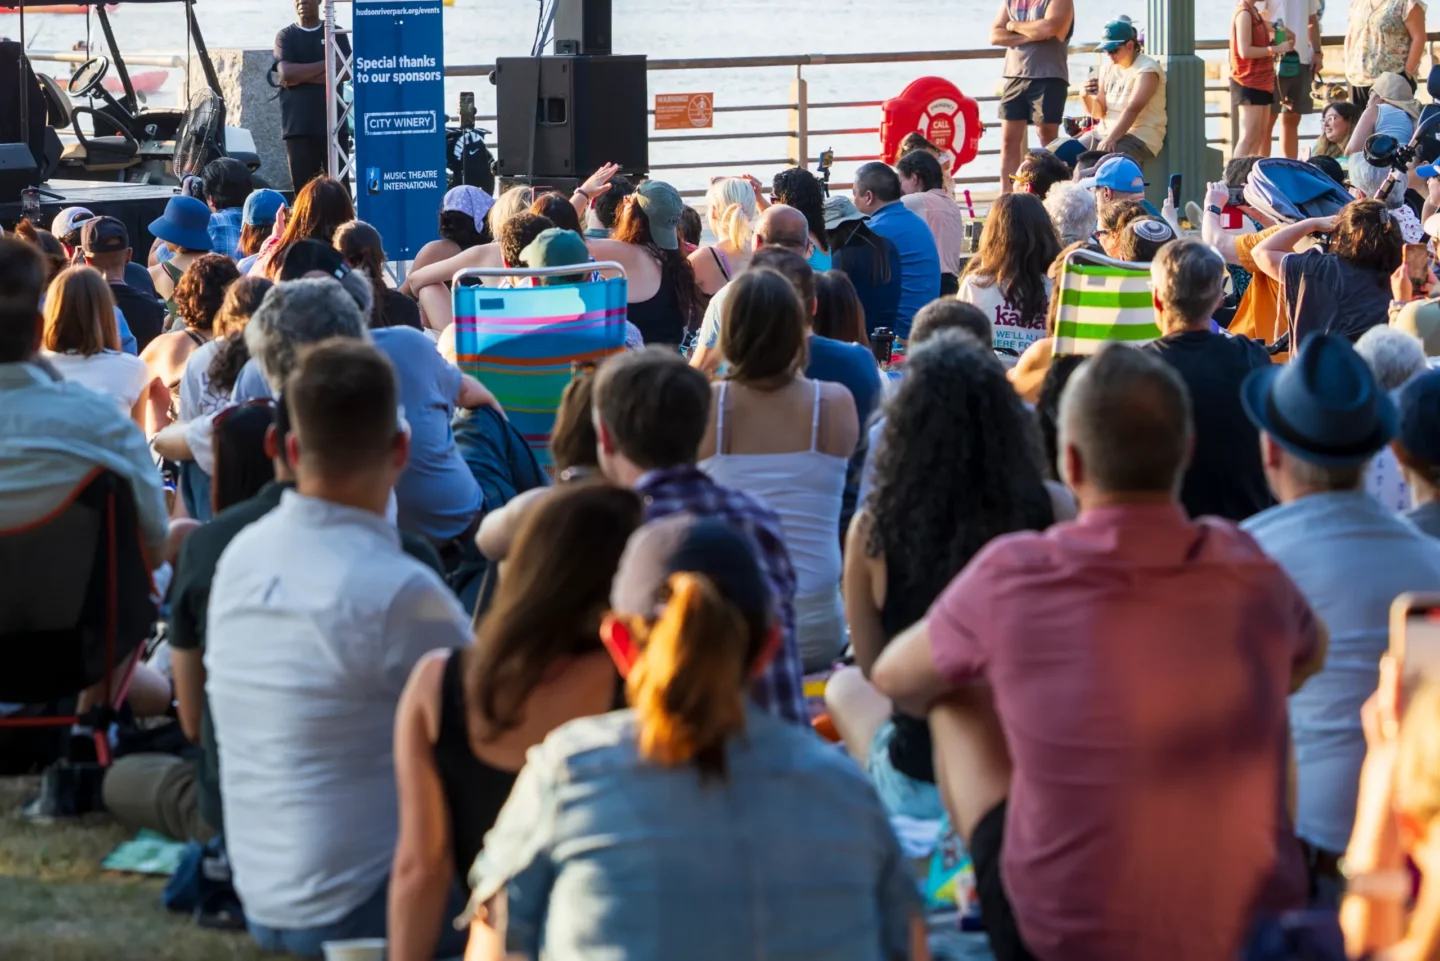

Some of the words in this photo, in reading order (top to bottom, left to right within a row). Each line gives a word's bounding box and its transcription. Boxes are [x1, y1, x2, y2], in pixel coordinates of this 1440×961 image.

[355, 6, 440, 17] hudsonriverpark.org/events
[357, 55, 397, 72] Special
[399, 54, 436, 68] thanks
[357, 72, 369, 83] to
[371, 72, 391, 83] our
[392, 71, 441, 85] sponsors
[369, 118, 392, 129] CITY
[394, 116, 431, 128] WINERY
[933, 119, 950, 129] CALL
[383, 171, 407, 181] MUSIC
[408, 170, 438, 179] THEATRE
[383, 180, 438, 191] INTERNATIONAL
